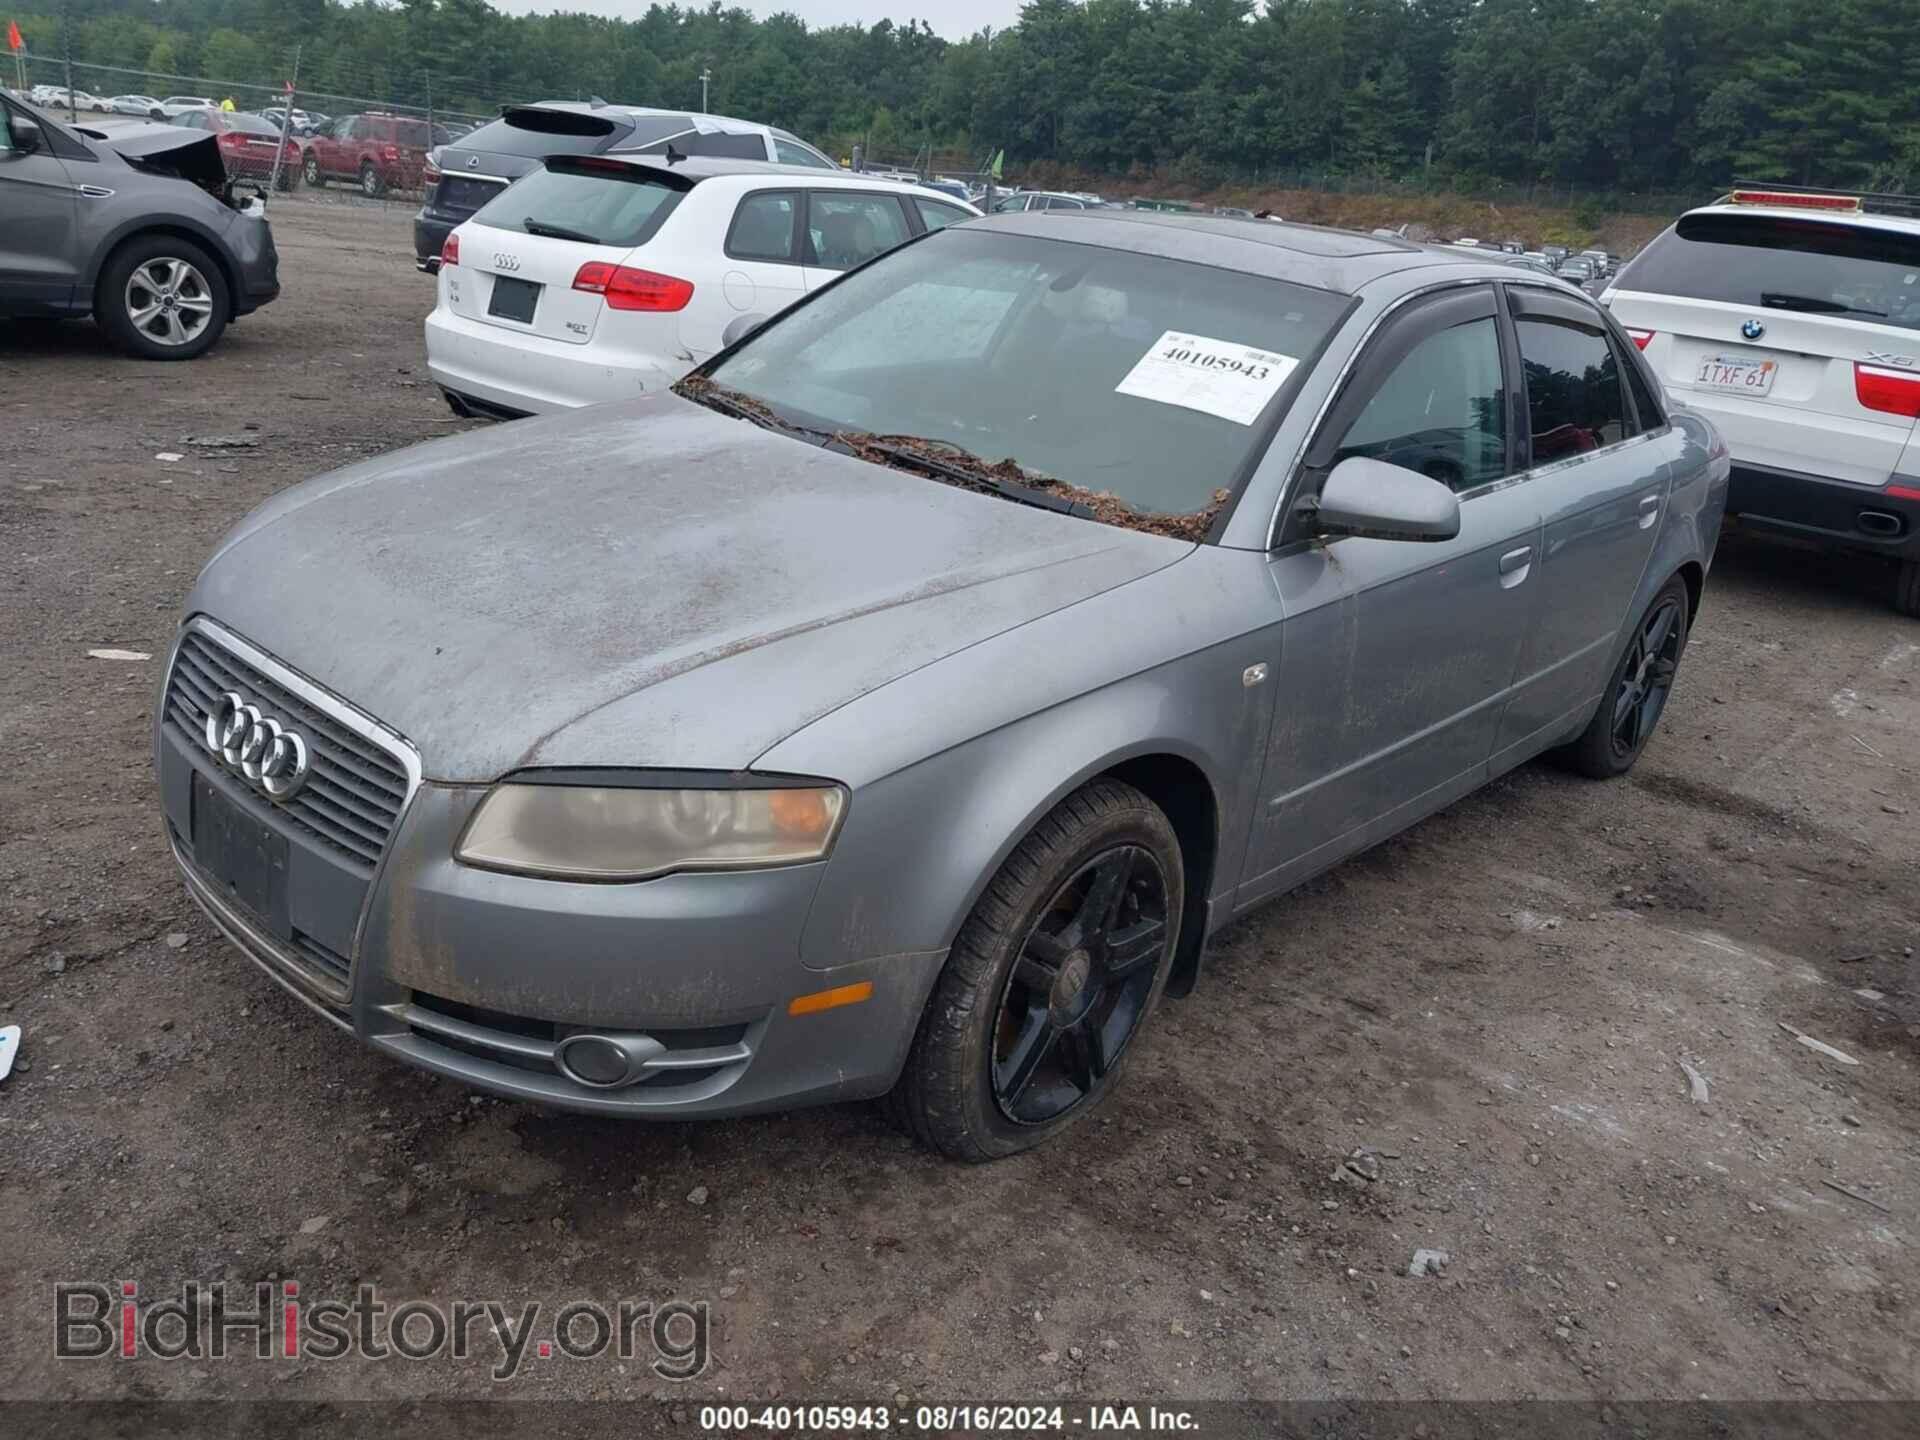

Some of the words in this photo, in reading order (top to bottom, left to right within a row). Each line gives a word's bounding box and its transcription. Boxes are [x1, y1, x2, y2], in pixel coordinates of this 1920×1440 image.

[1162, 347, 1270, 380] 40105943
[1699, 364, 1744, 384] 1TXF
[1745, 368, 1769, 388] 61
